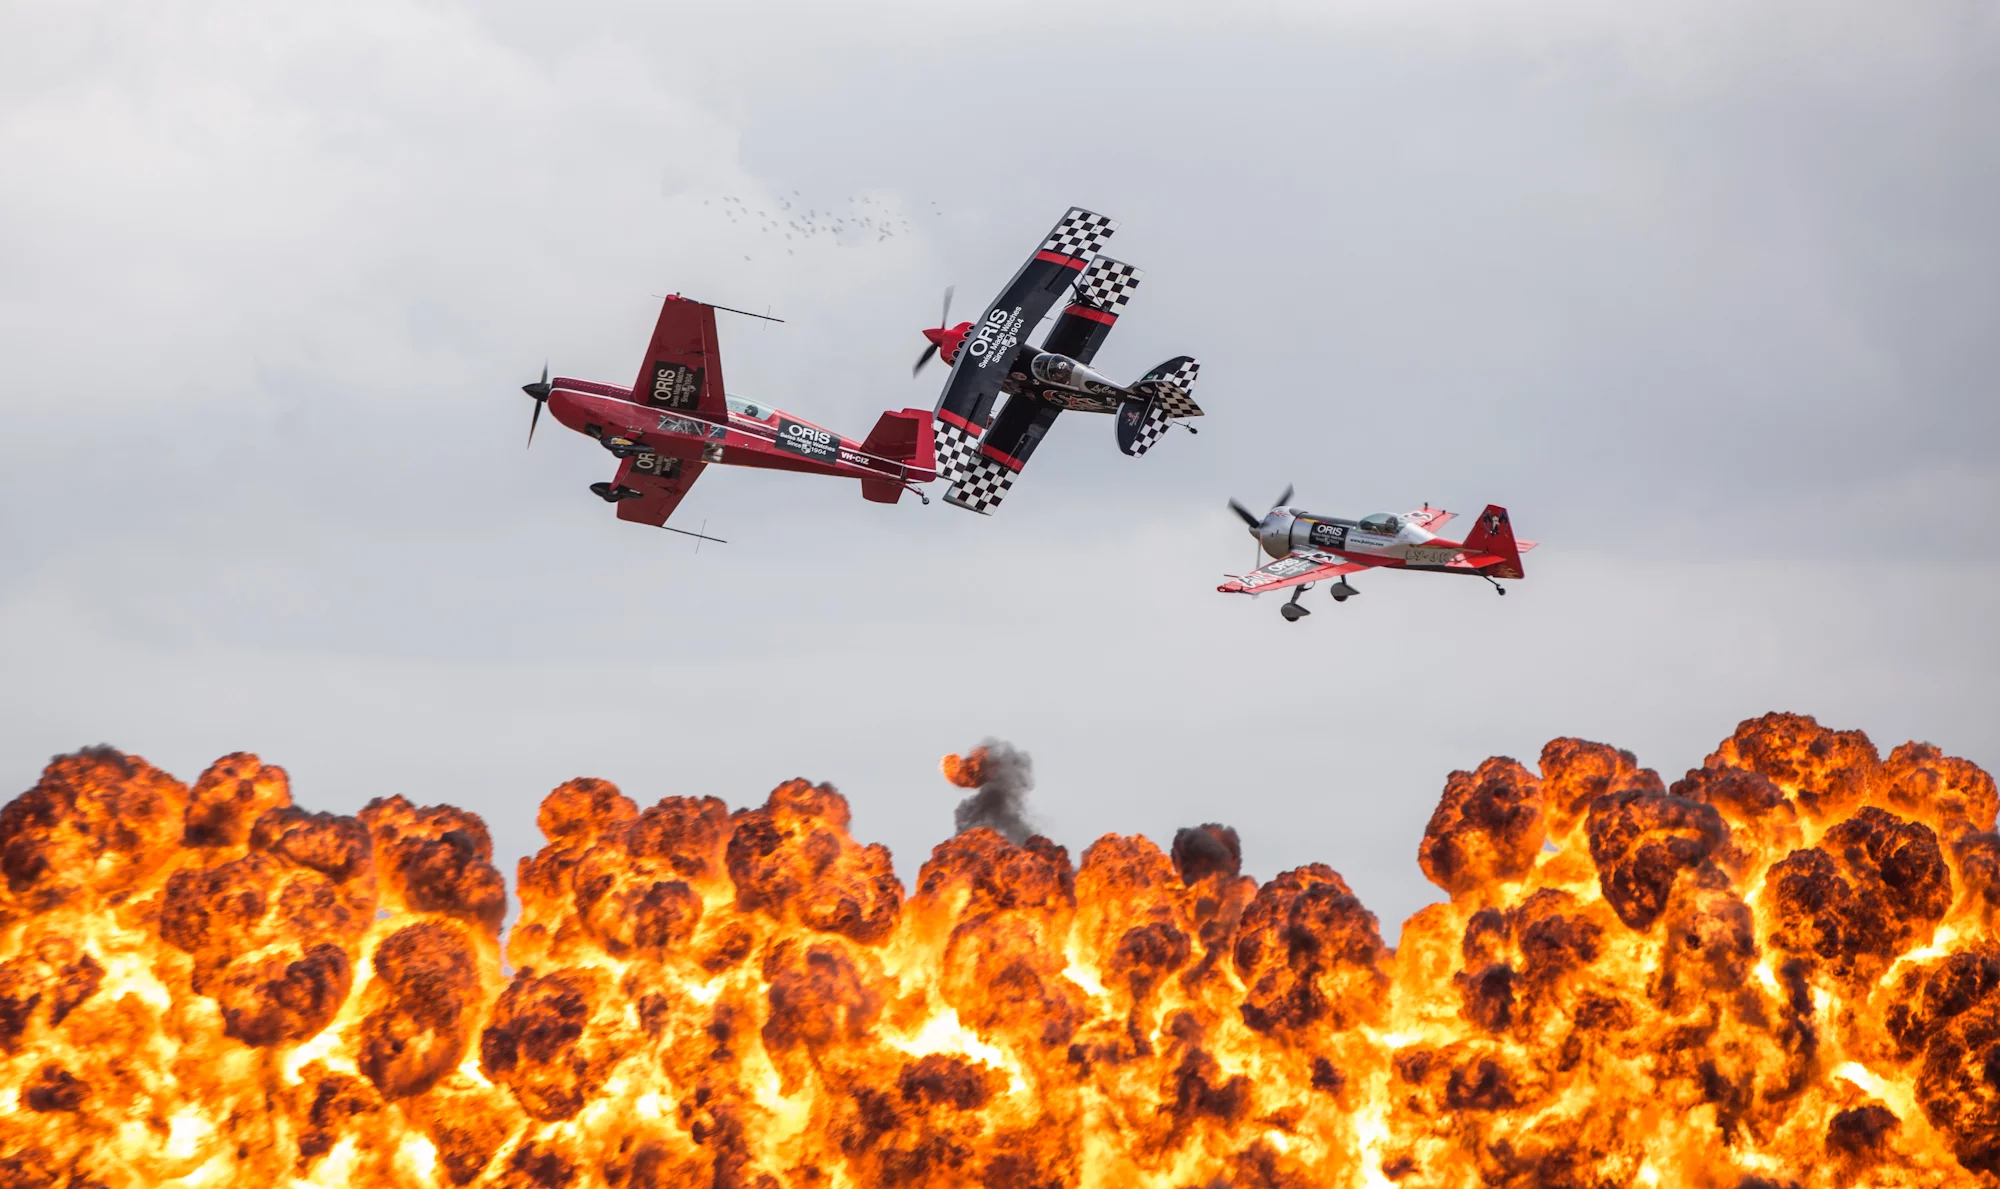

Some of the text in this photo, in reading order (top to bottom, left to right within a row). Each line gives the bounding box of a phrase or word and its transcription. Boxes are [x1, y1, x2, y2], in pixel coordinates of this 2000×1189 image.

[970, 309, 1008, 357] ORIS
[978, 306, 1022, 368] Swiss Made Watches
[992, 318, 1024, 363] Since 1904
[653, 369, 676, 400] ORIS
[780, 432, 835, 452] Swiss Made Watches
[789, 424, 831, 444] ORIS
[786, 440, 826, 455] Since 1904
[841, 451, 870, 465] VH-CIZ
[1317, 524, 1343, 536] ORIS
[1268, 558, 1299, 571] ORIS
